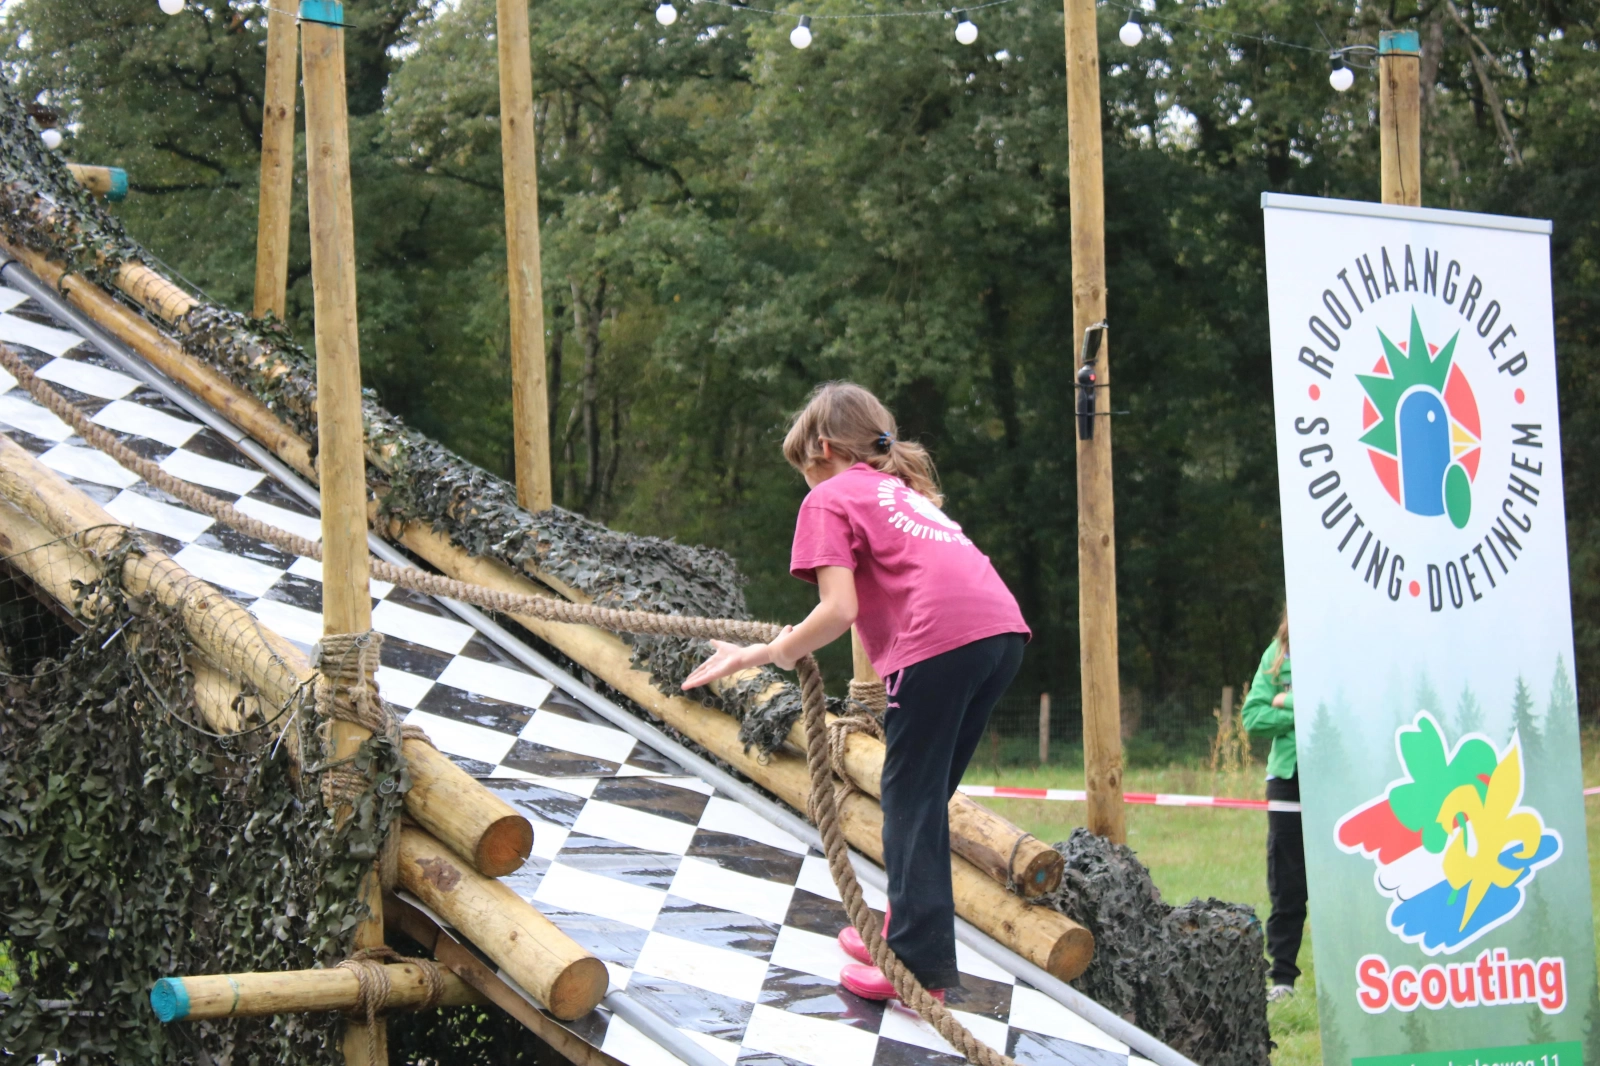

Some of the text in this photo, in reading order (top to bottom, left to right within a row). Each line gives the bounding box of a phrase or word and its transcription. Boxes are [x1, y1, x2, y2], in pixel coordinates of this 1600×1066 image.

[1298, 244, 1528, 380] ROOTHAANGROEP
[888, 511, 952, 543] SCOUTING
[1294, 416, 1405, 601] SCOUTING
[1427, 423, 1543, 612] DOETINCHEM
[1358, 951, 1565, 1012] Scouting
